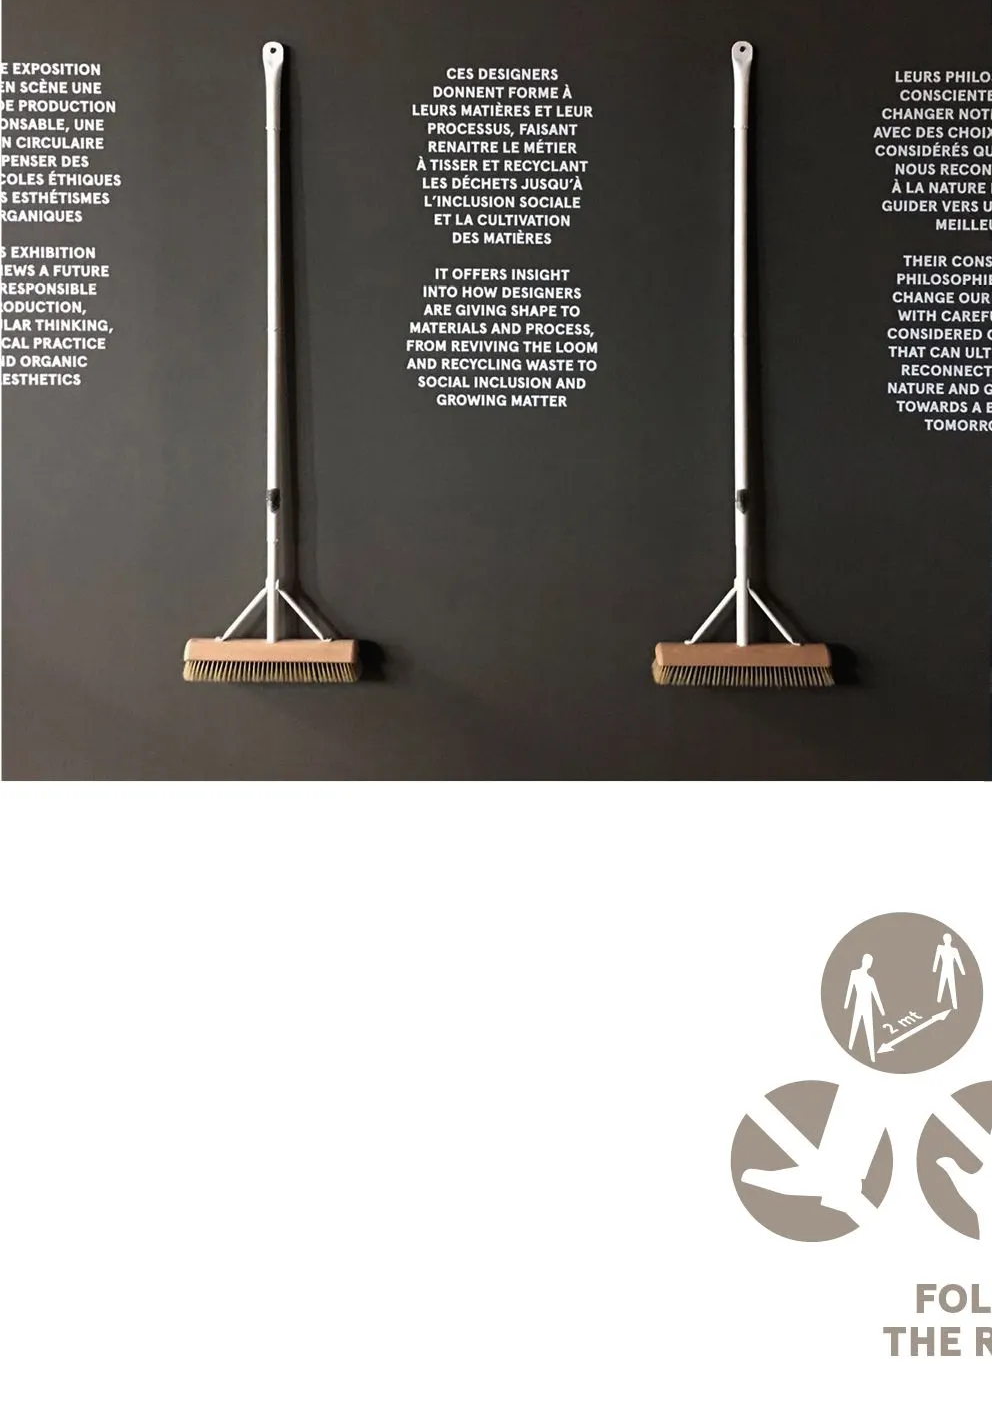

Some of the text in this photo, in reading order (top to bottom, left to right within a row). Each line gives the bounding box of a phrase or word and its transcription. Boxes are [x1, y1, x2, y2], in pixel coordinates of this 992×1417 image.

[12, 62, 101, 77] EXPOSITION
[446, 67, 559, 81] CES DESIGNERS
[895, 70, 941, 83] LEURS
[19, 77, 102, 95] SCÈNE UNE
[432, 83, 573, 99] DONNENT FORME À
[18, 99, 116, 114] PRODUCTION
[412, 101, 594, 118] LEURS MATIÈRES ET LEUR
[881, 107, 955, 120] CHANGER
[73, 118, 105, 132] UNE
[427, 122, 578, 138] PROCESSUS, FAISANT
[873, 126, 944, 139] AVEC DES
[15, 135, 105, 150] CIRCULAIRE
[428, 138, 577, 155] RENAITRE LE MÉTIER
[874, 141, 969, 157] CONSIDÉRÉS
[416, 155, 589, 173] À TISSER ET RECYCLANT
[895, 163, 936, 176] NOUS
[47, 169, 122, 187] ÉTHIQUES
[422, 174, 583, 191] LES DÉCHETS JUSQU’À
[891, 178, 987, 194] À LA NATURE
[11, 188, 111, 205] ESTHÉTISMES
[424, 194, 581, 209] L’INCLUSION SOCIALE
[881, 199, 979, 213] GUIDER VERS
[434, 213, 571, 227] ET LA CULTIVATION
[452, 229, 552, 245] DES MATIÈRES
[10, 245, 96, 260] EXHIBITION
[902, 254, 948, 268] THEIR
[38, 264, 110, 278] A FUTURE
[435, 267, 571, 281] IT OFFERS INSIGHT
[892, 291, 991, 304] CHANGE OUR
[34, 318, 114, 335] THINKING,
[409, 321, 595, 338] MATERIALS AND PROCESS,
[32, 336, 107, 350] PRACTICE
[19, 354, 88, 368] ORGANIC
[901, 364, 992, 377] RECONNECT
[417, 375, 587, 390] SOCIAL INCLUSION AND
[436, 393, 568, 408] GROWING MATTER
[895, 400, 982, 414] TOWARDS A
[882, 1010, 923, 1035] 2 mt
[882, 1326, 962, 1357] THE
